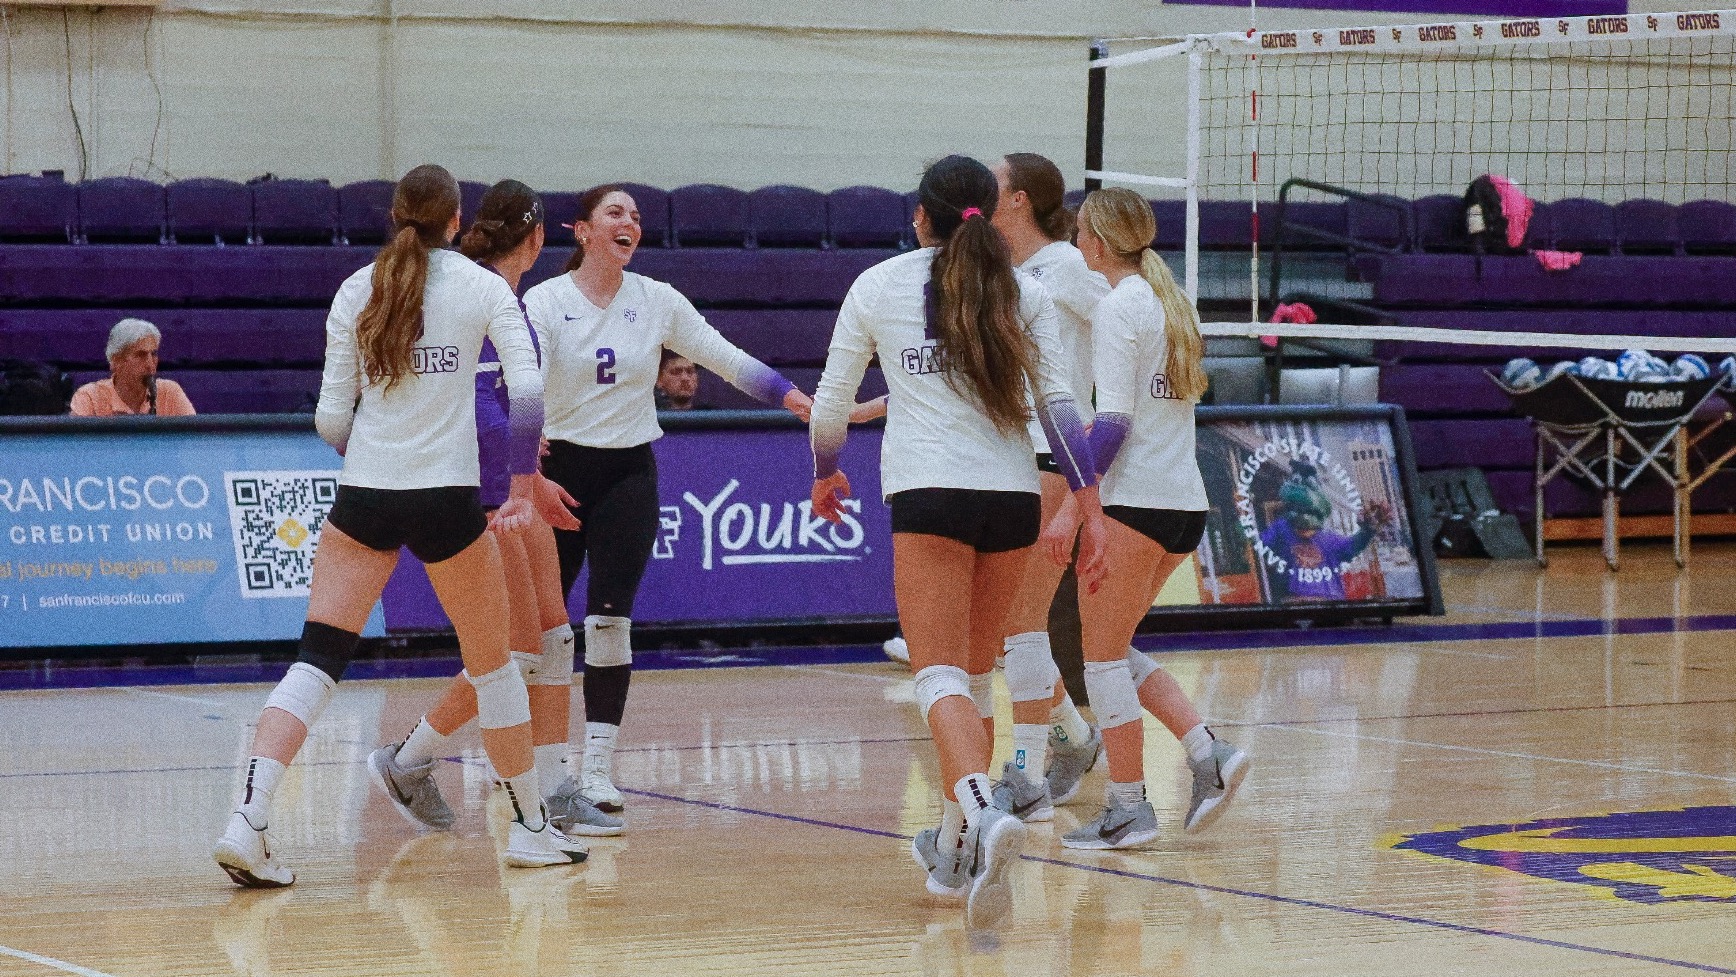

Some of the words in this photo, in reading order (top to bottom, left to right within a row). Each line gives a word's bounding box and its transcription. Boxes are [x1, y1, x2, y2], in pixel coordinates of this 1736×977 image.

[1261, 33, 1297, 48] GATORS
[1339, 29, 1376, 45] GATORS
[1418, 25, 1456, 41] GATORS
[1501, 21, 1540, 38] GATORS
[1558, 20, 1569, 35] SF
[1587, 17, 1628, 34] GATORS
[1647, 15, 1658, 31] SF
[1677, 13, 1720, 31] GATORS
[596, 347, 616, 385] 2
[0, 474, 209, 512] RANCISCO
[9, 525, 111, 545] CREDIT
[126, 522, 213, 542] UNION
[18, 561, 93, 582] journey
[99, 557, 168, 579] begins
[172, 554, 217, 573] here
[1254, 540, 1288, 573] SAN
[1298, 567, 1332, 582] 1899
[39, 591, 185, 609] sanfranciscofcu.com
